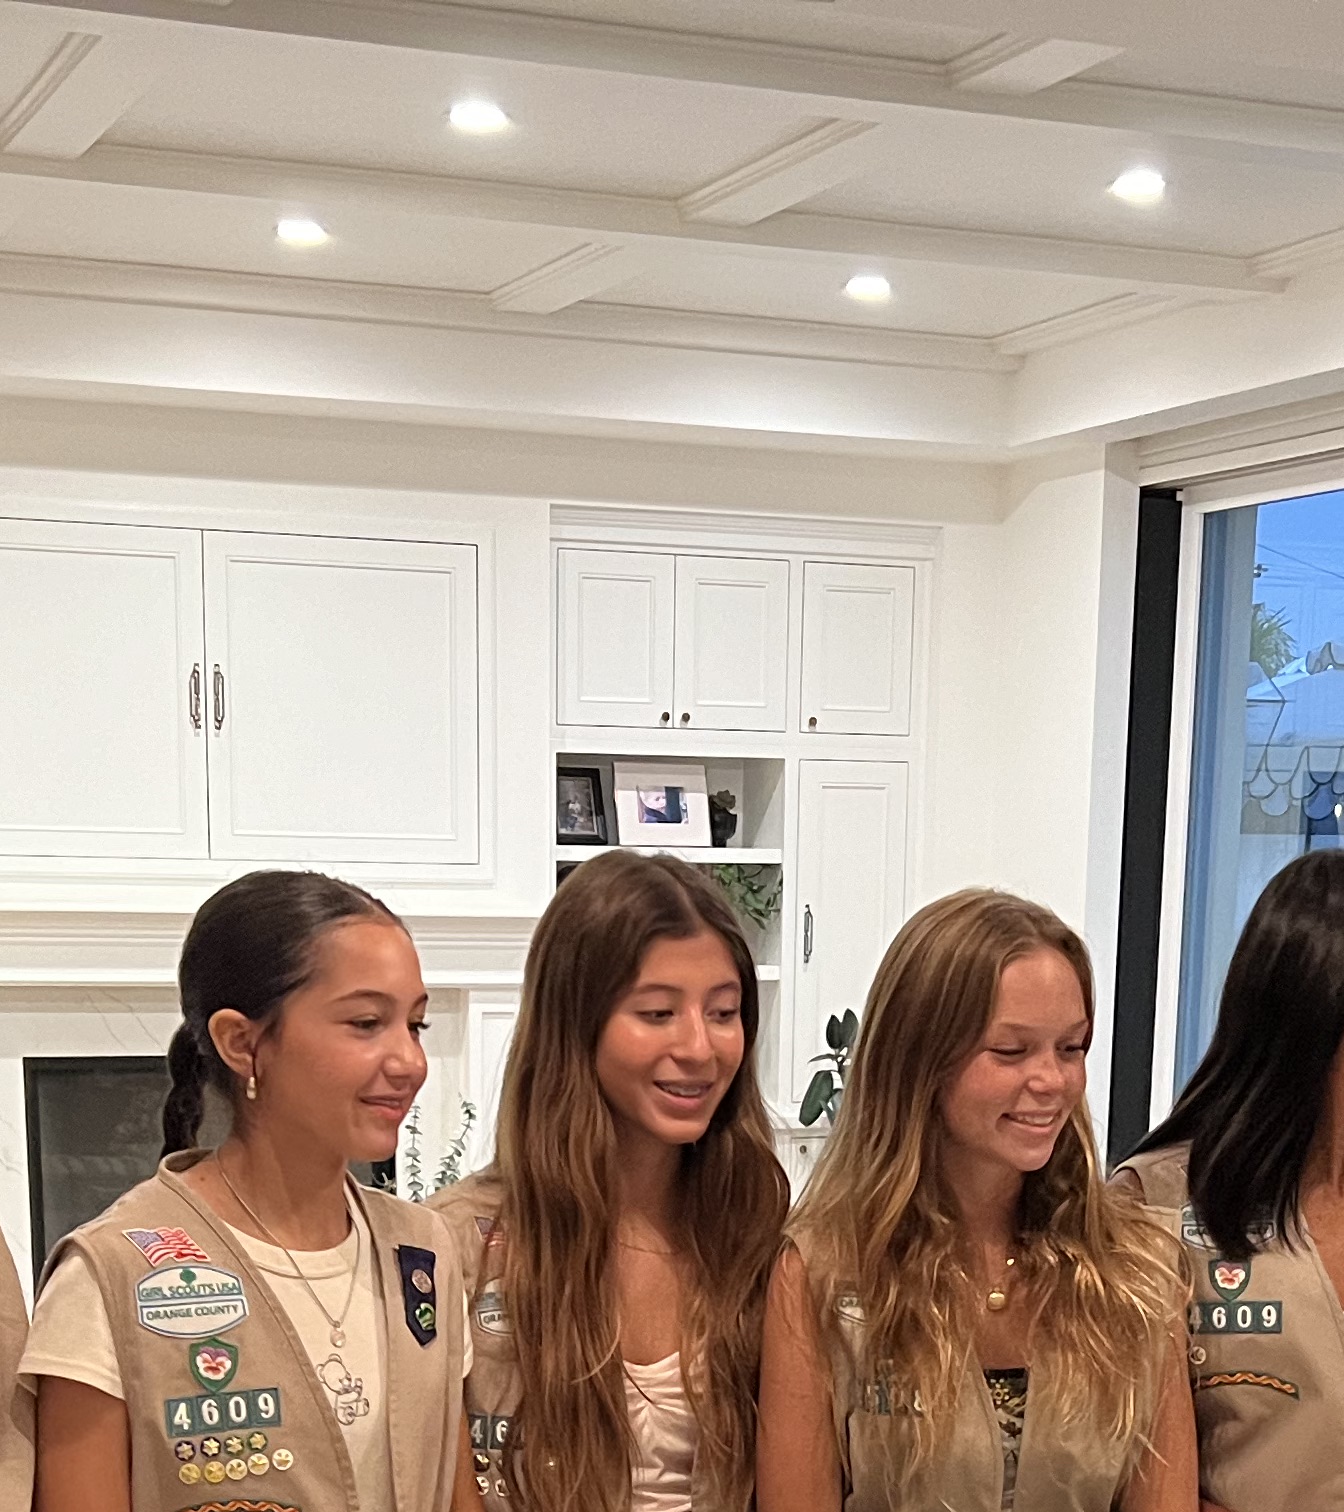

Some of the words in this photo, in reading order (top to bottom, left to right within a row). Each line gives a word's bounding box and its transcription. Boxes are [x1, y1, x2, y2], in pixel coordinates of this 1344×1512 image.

[168, 1284, 216, 1298] SCOUTS
[217, 1281, 240, 1294] USA
[146, 1307, 193, 1321] ORANGE
[194, 1304, 239, 1317] COUNTY
[173, 1392, 276, 1431] 4609
